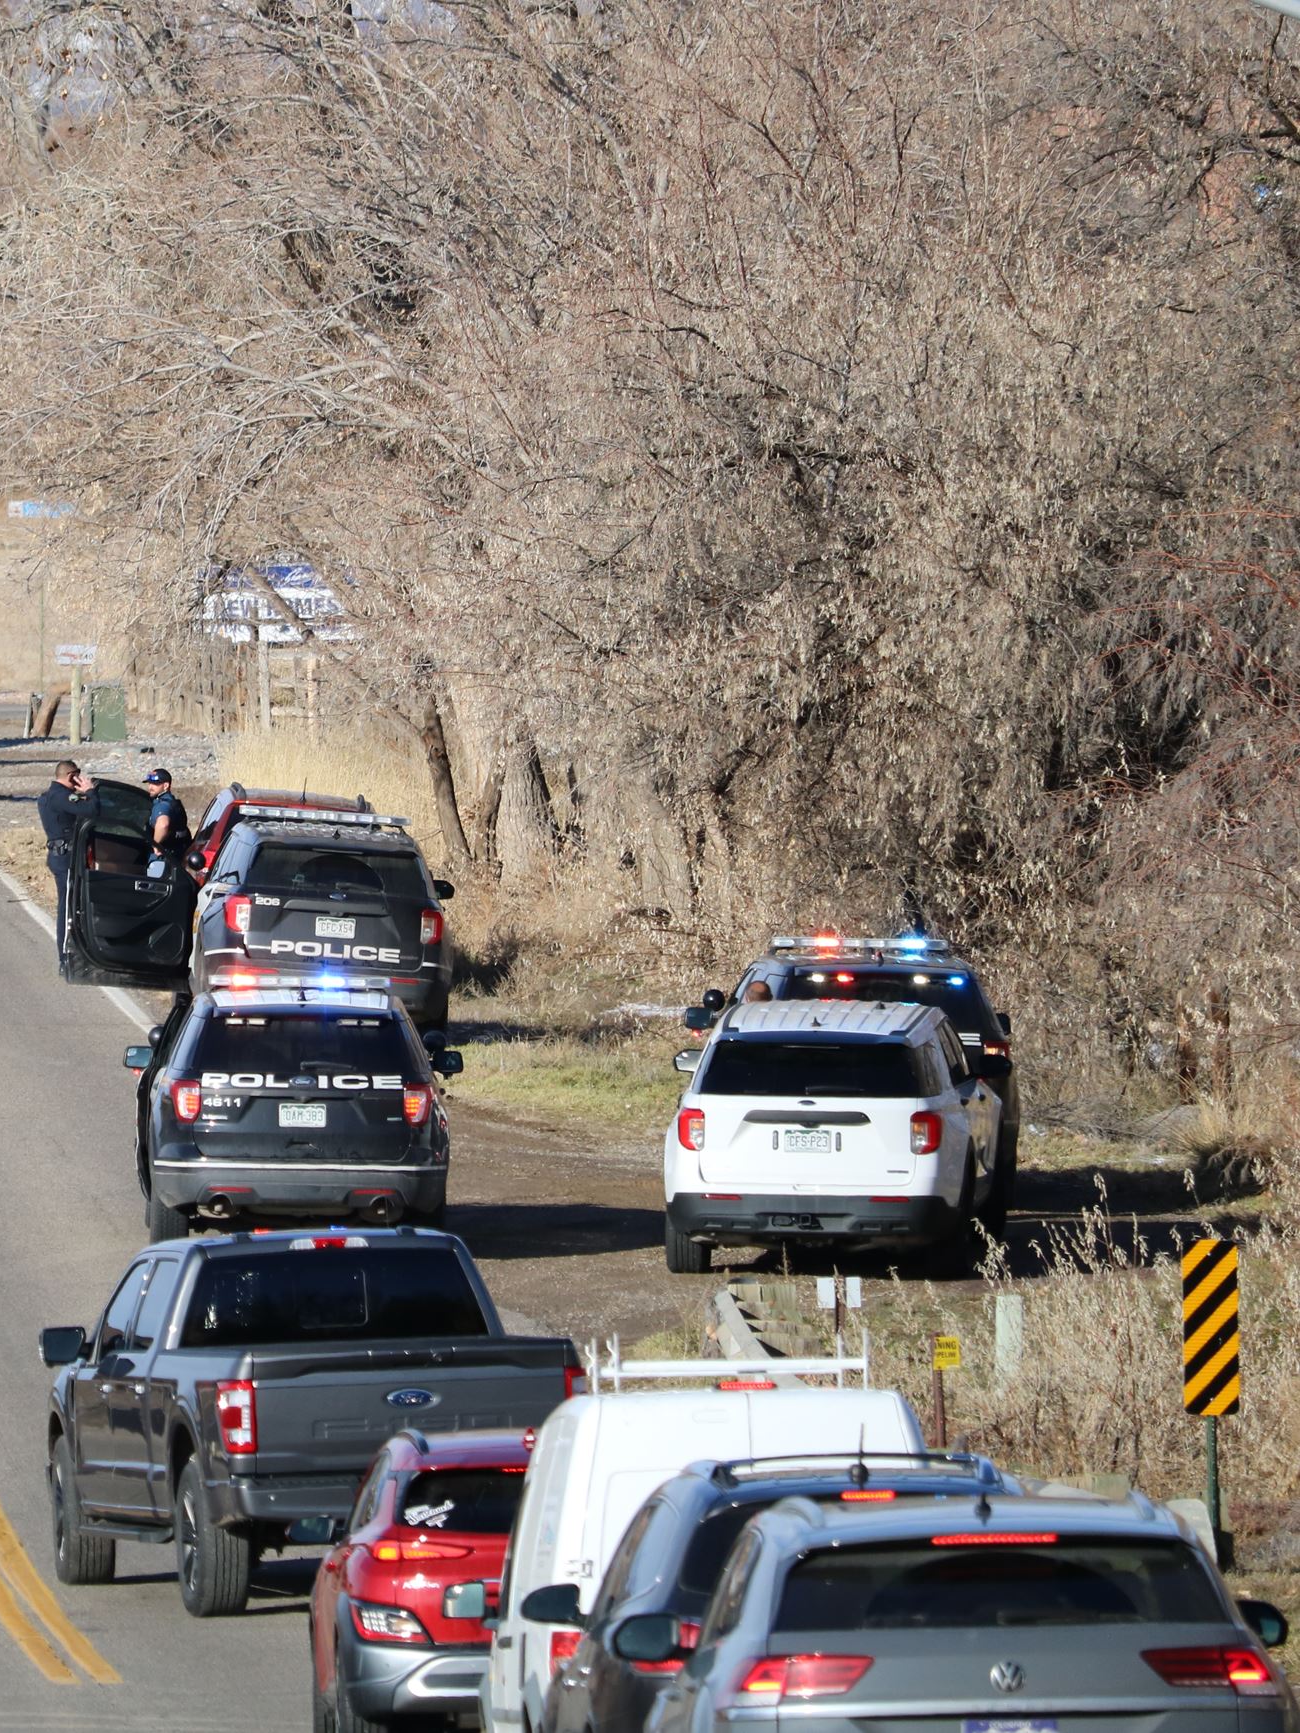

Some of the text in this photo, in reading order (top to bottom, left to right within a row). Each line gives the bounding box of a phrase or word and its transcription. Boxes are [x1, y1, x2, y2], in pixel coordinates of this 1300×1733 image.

[255, 896, 280, 906] 206
[270, 940, 401, 964] POLICE
[201, 1073, 403, 1090] POLICE
[203, 1097, 241, 1107] 4611
